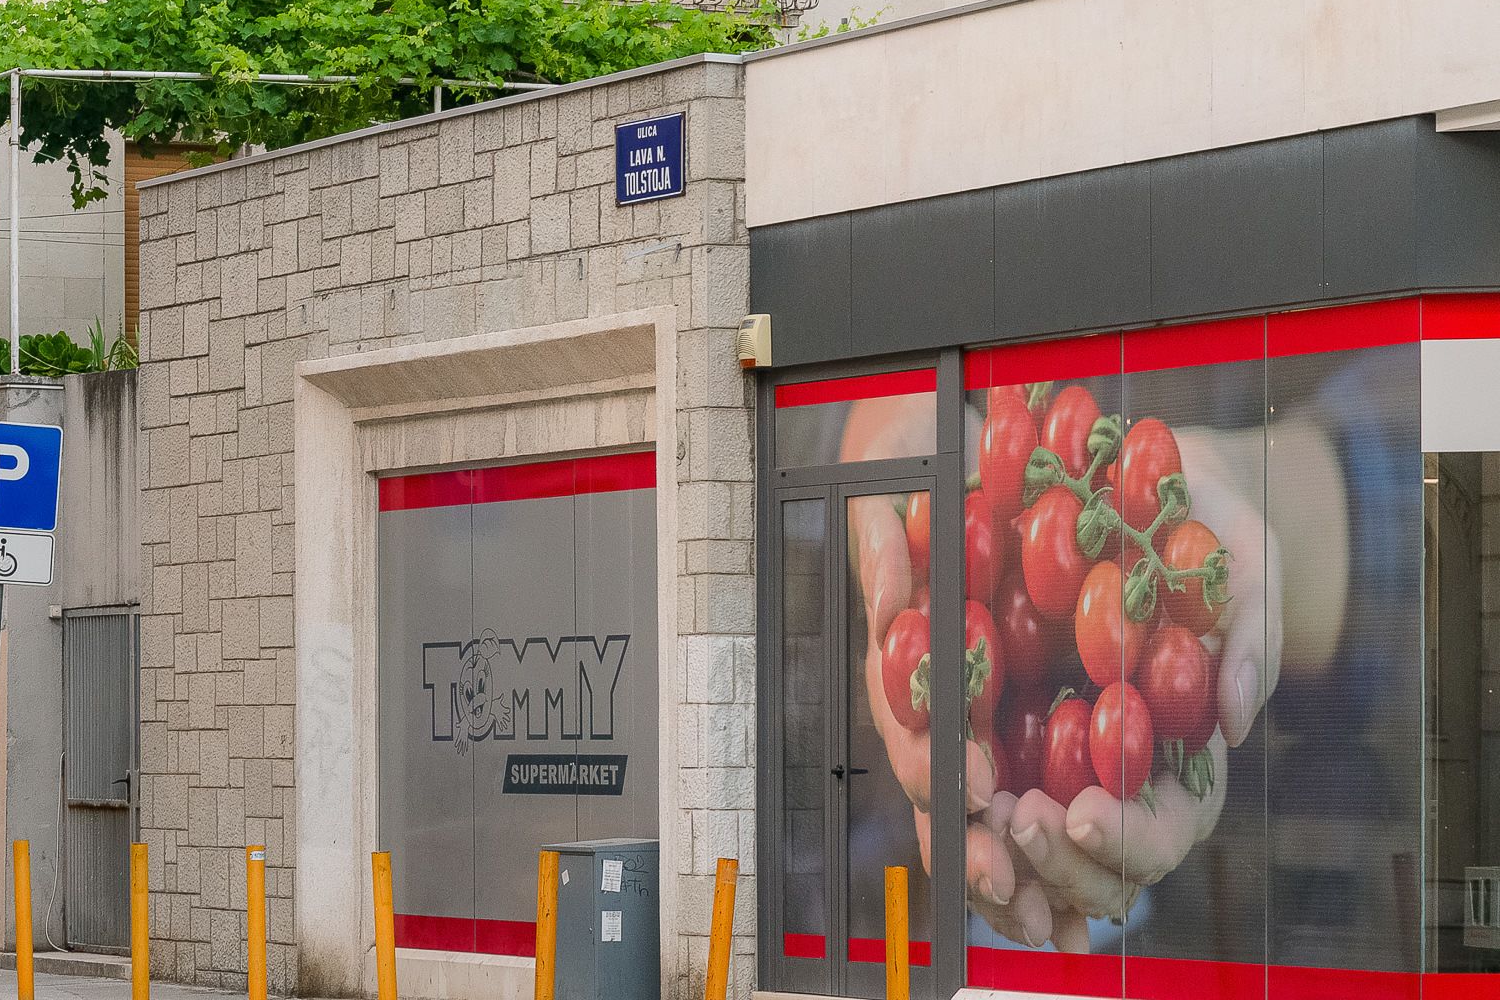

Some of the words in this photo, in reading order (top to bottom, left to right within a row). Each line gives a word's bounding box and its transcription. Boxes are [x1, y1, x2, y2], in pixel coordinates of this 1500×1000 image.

[637, 125, 657, 139] ULICA
[629, 147, 653, 167] LAVA
[657, 145, 666, 162] N.
[624, 166, 671, 196] TOLSTOJA
[510, 763, 619, 786] SUPERMARKET
